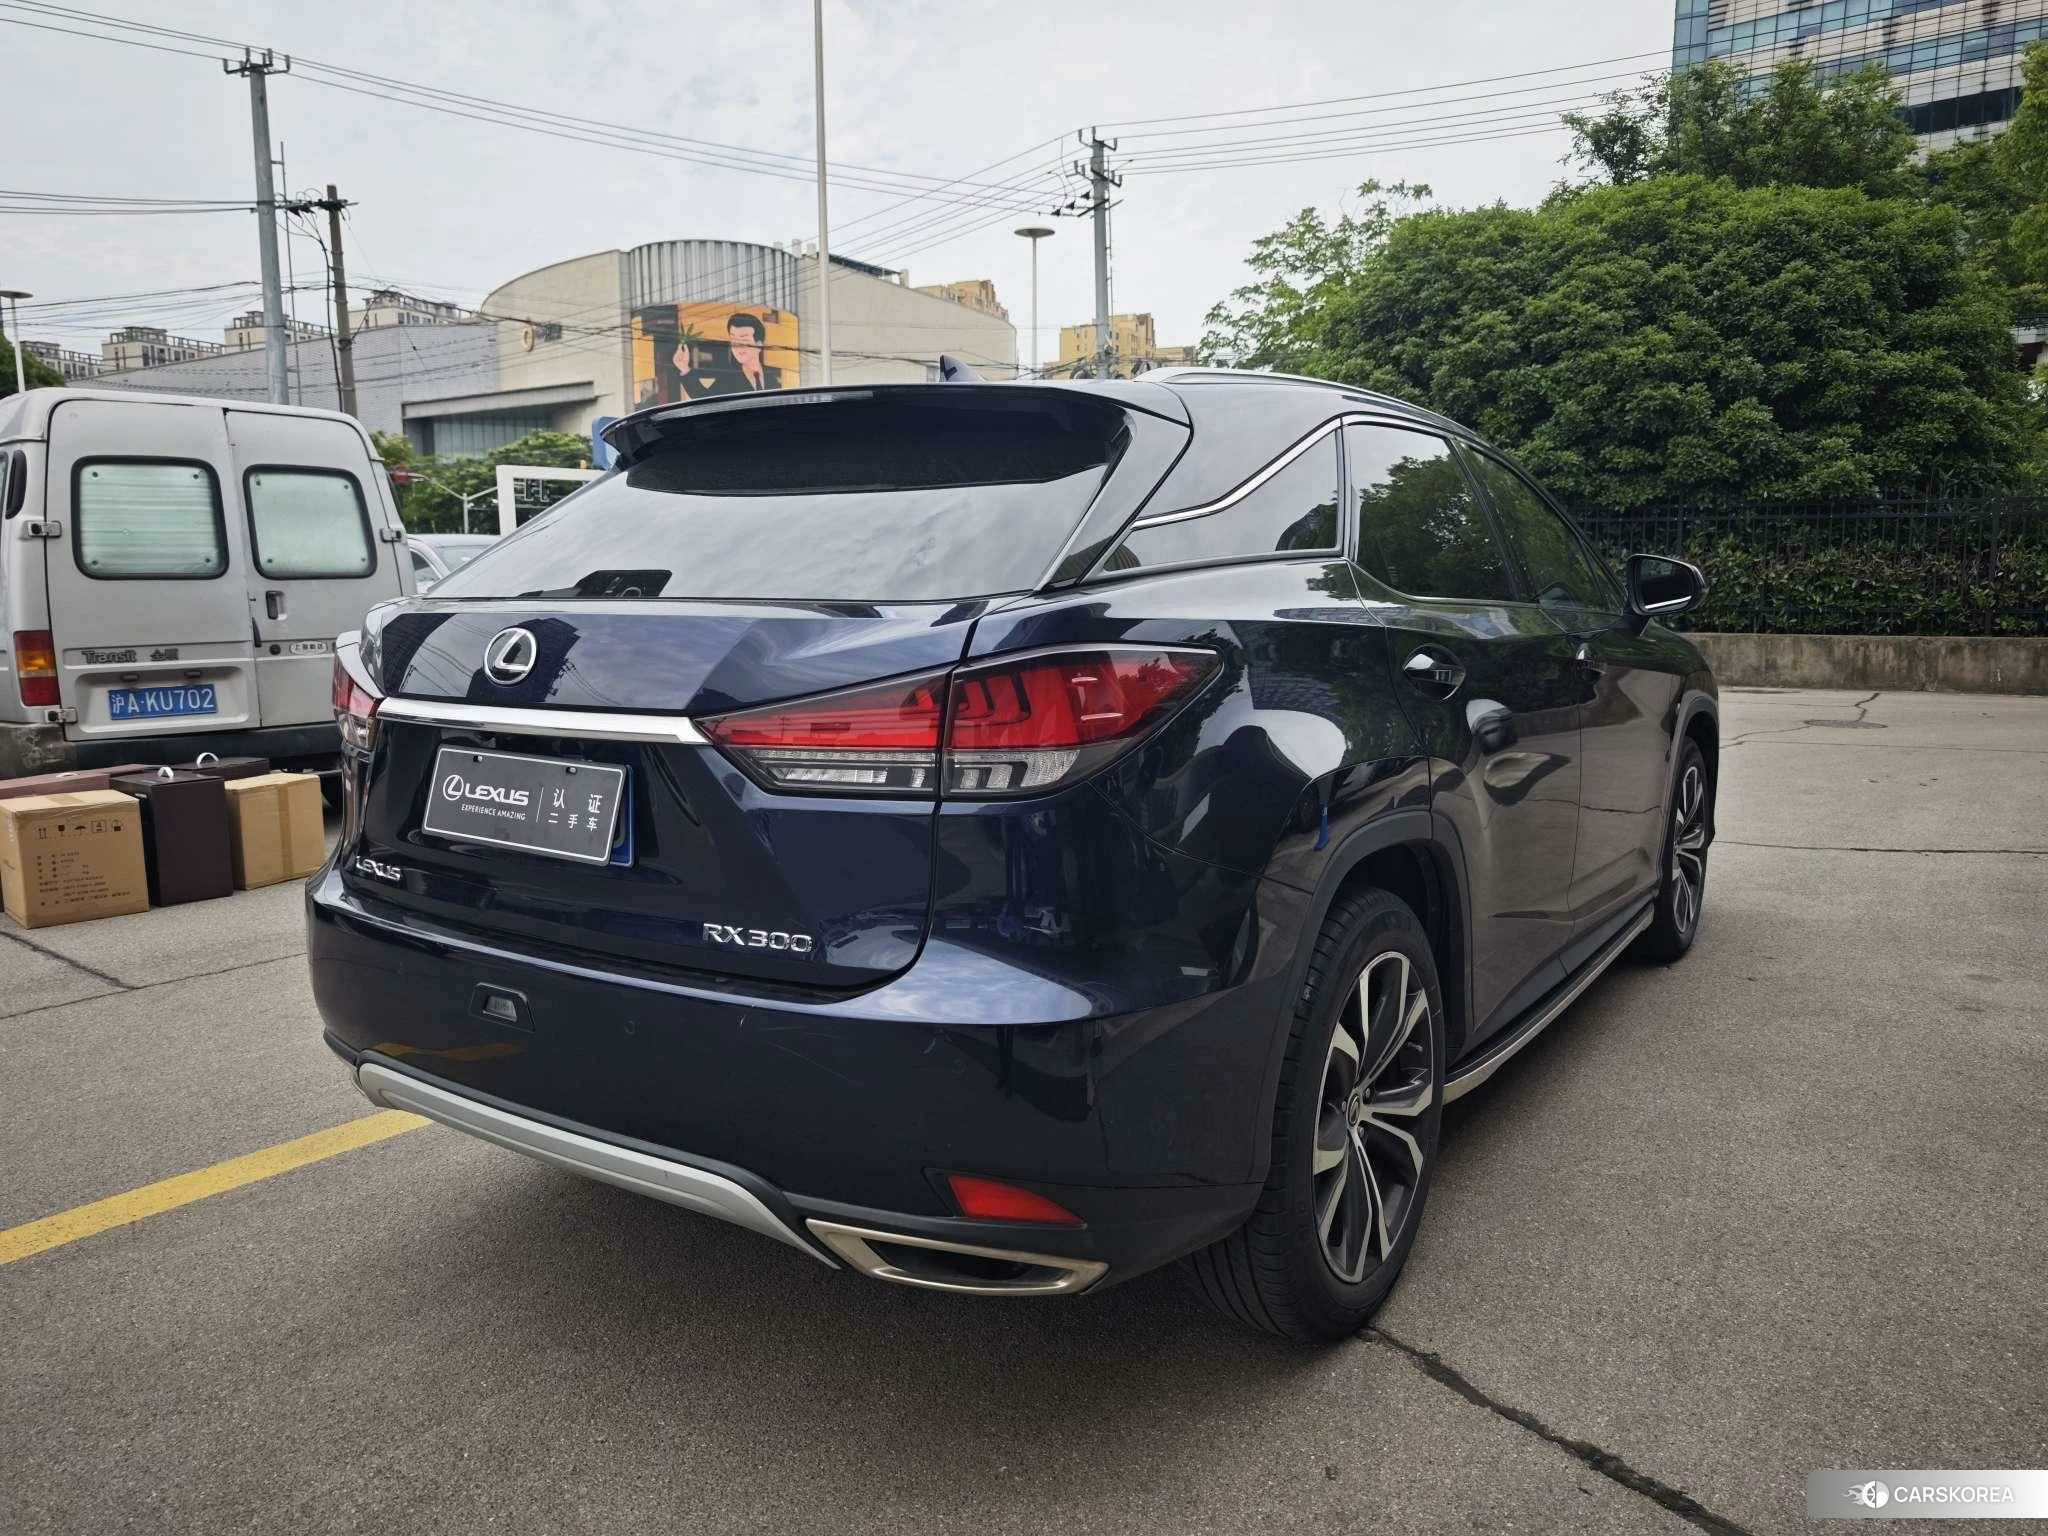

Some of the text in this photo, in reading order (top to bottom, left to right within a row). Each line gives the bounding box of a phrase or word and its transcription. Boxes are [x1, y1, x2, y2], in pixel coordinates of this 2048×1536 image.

[465, 783, 529, 806] LEXUS
[461, 803, 527, 821] EXPERIENCE AMAZING
[355, 855, 401, 881] LEXUS
